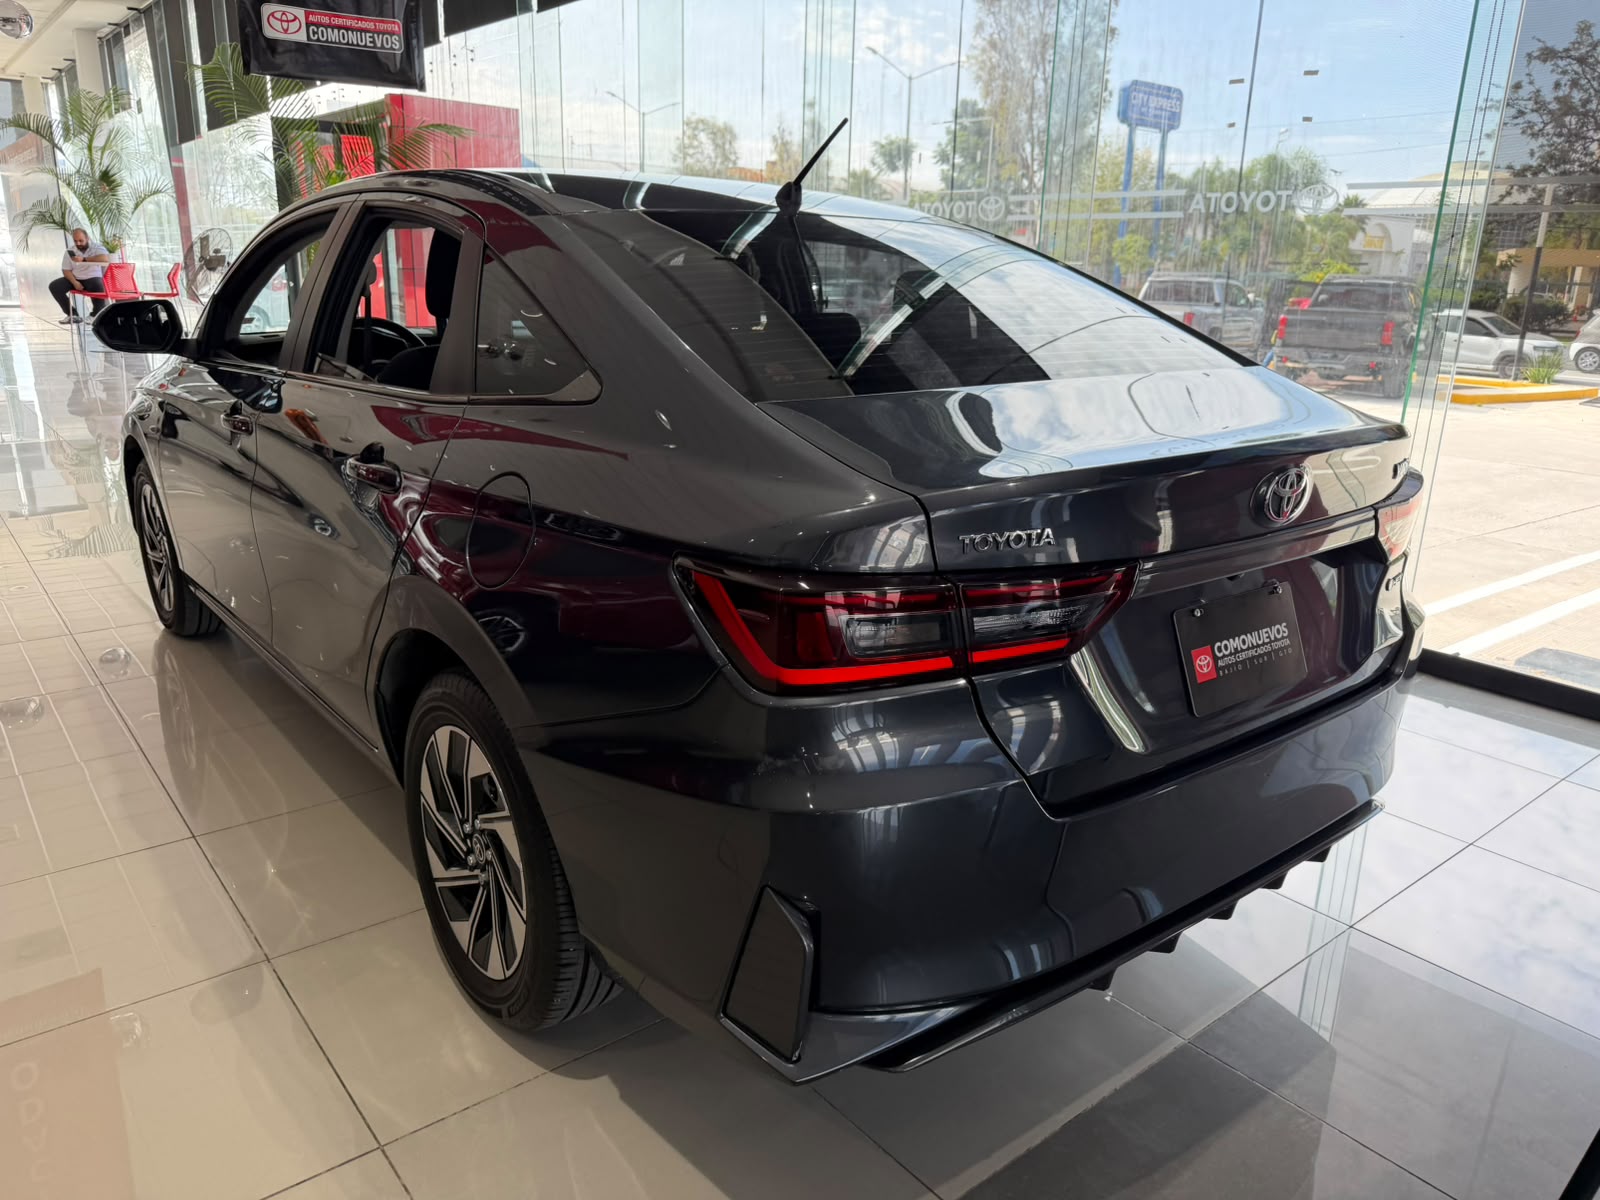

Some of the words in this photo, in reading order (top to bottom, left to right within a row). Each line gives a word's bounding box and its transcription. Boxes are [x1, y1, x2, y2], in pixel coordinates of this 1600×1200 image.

[308, 14, 330, 23] AUTOS
[331, 17, 375, 29] CERTIFICADOS
[375, 22, 399, 31] TOYOTA
[309, 25, 400, 49] COMONUEVOS
[1131, 91, 1149, 107] CITY
[958, 528, 1056, 555] TOYOTA
[1214, 622, 1289, 657] COMONUEVOS
[1217, 655, 1236, 668] AUTOS
[1235, 643, 1272, 662] CERTIFICADOS
[1271, 638, 1291, 651] TOYOTA
